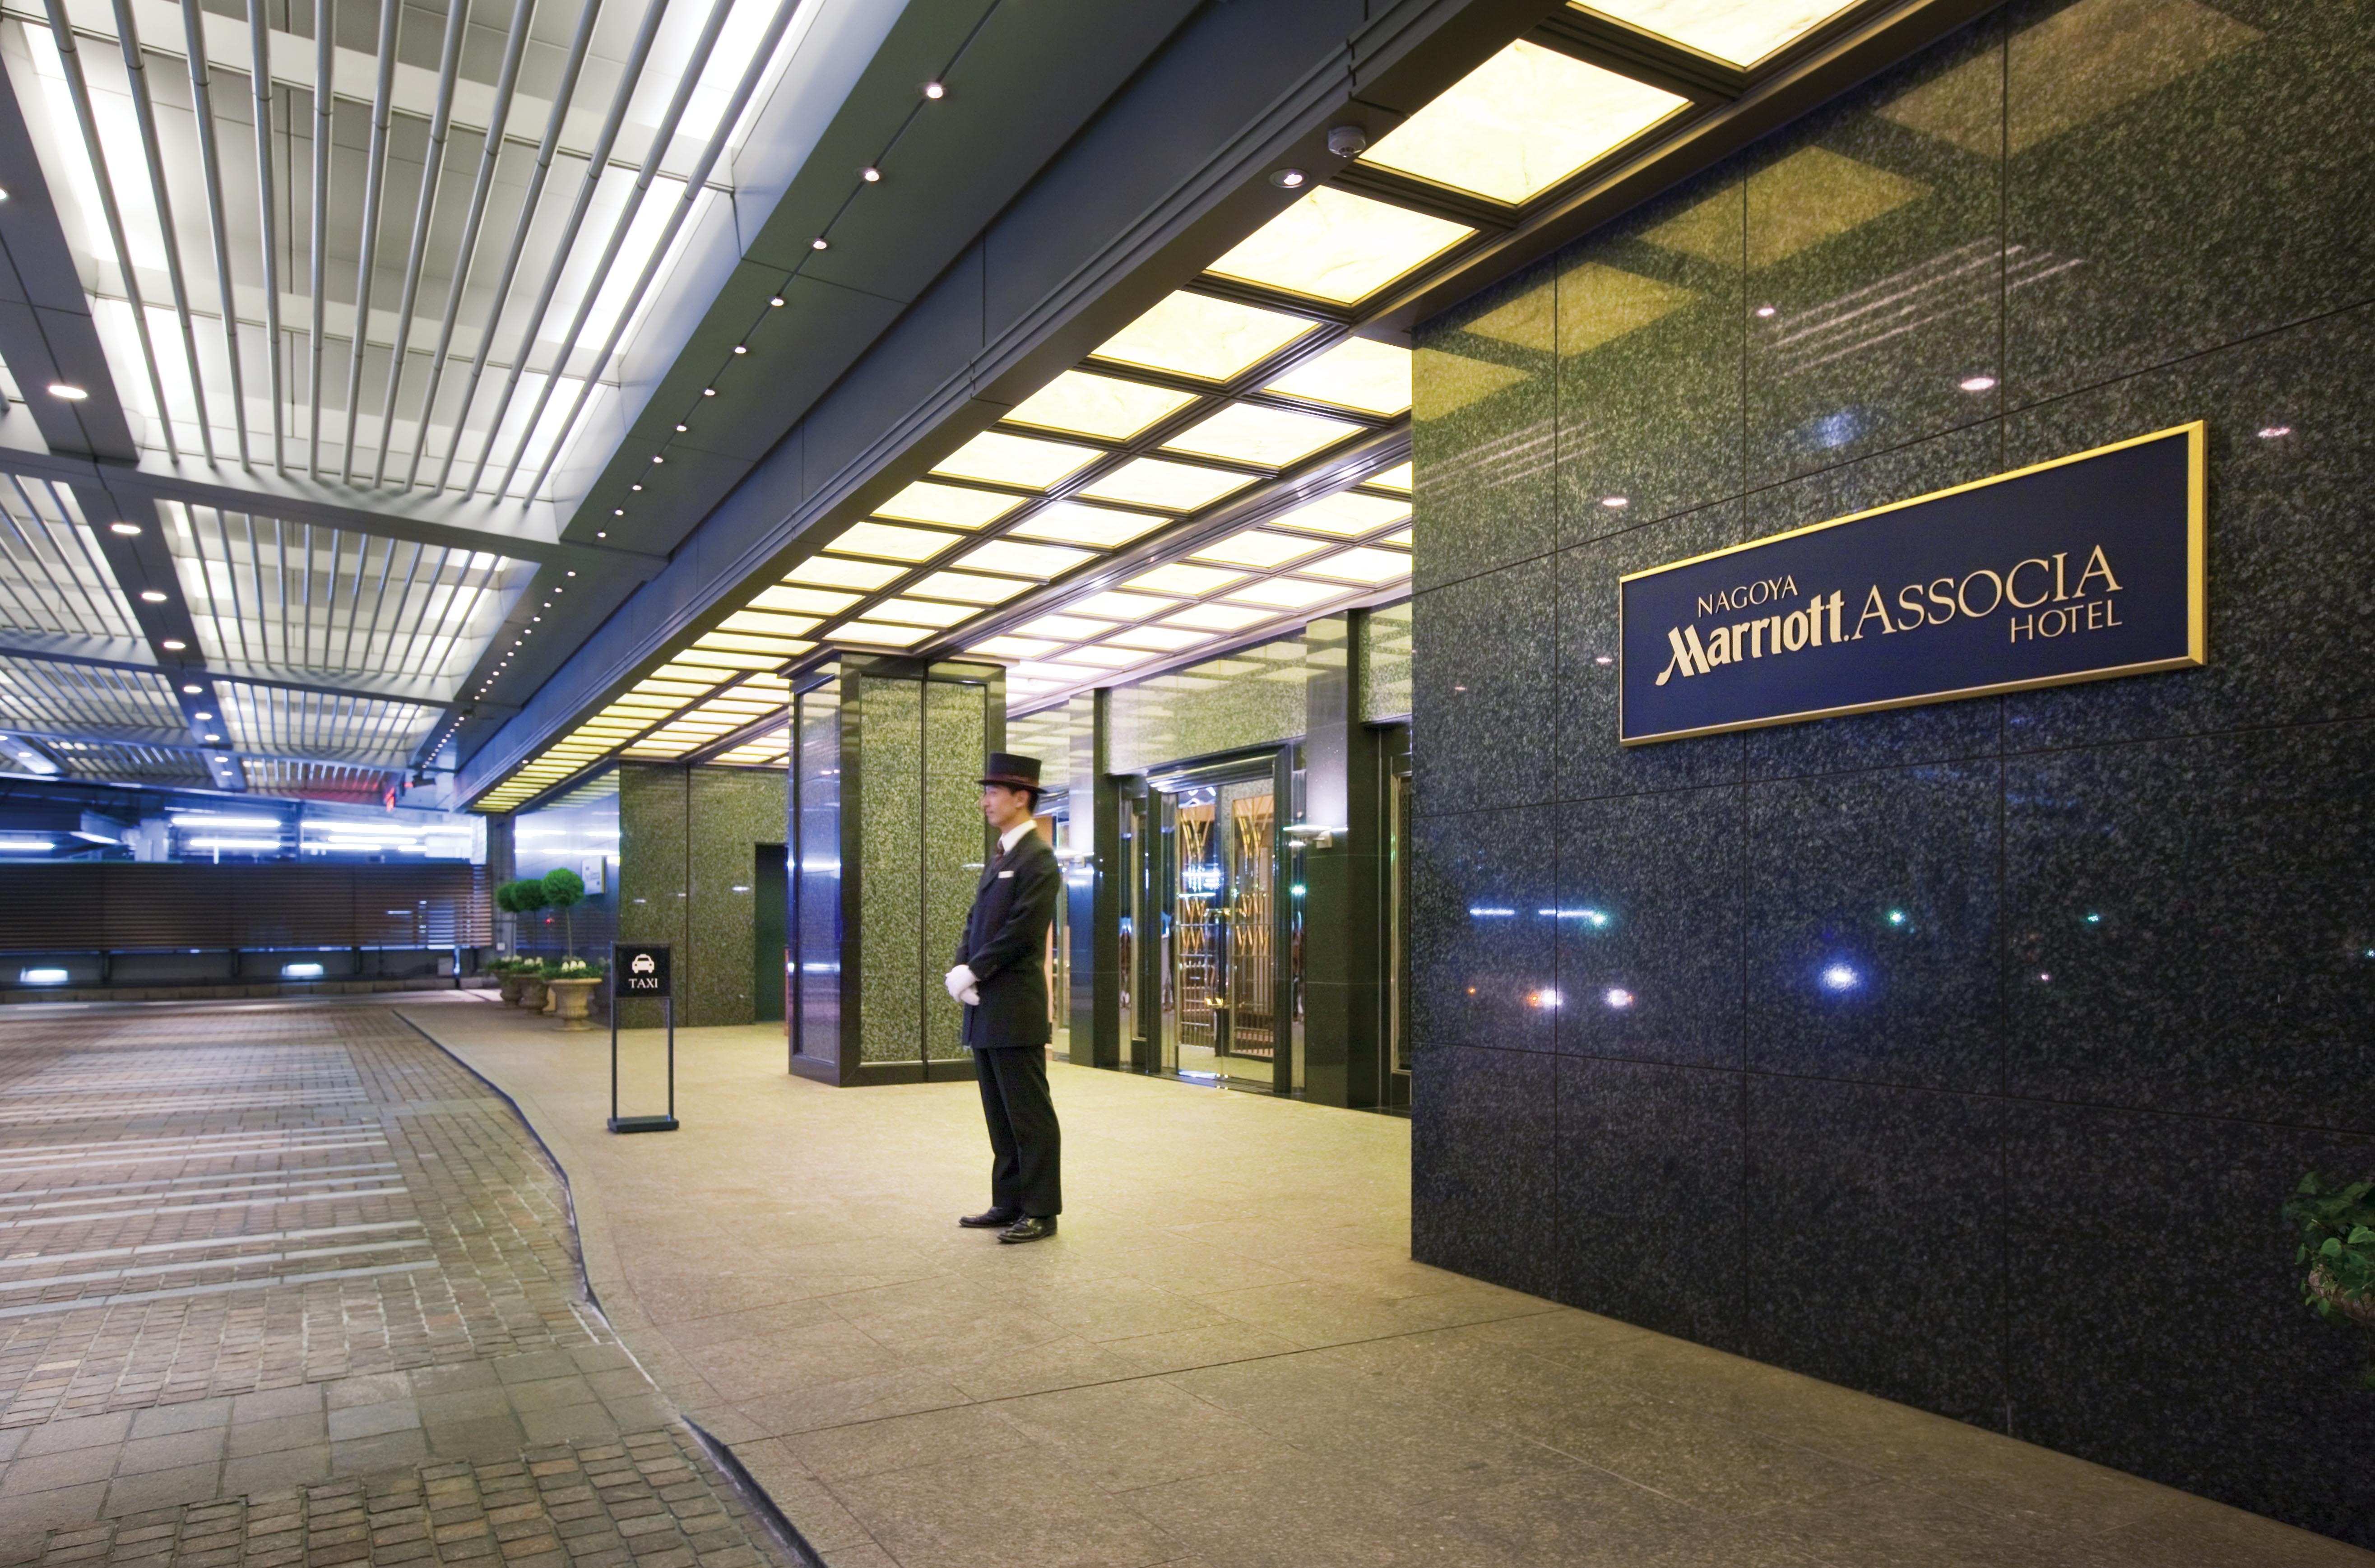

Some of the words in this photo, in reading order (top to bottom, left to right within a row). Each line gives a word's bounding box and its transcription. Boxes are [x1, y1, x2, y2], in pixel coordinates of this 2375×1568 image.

[1698, 575, 1798, 618] NAGOYA
[1851, 544, 2123, 640] ASSOCIA
[2011, 599, 2123, 643] HOTEL
[628, 978, 659, 988] TAXI
